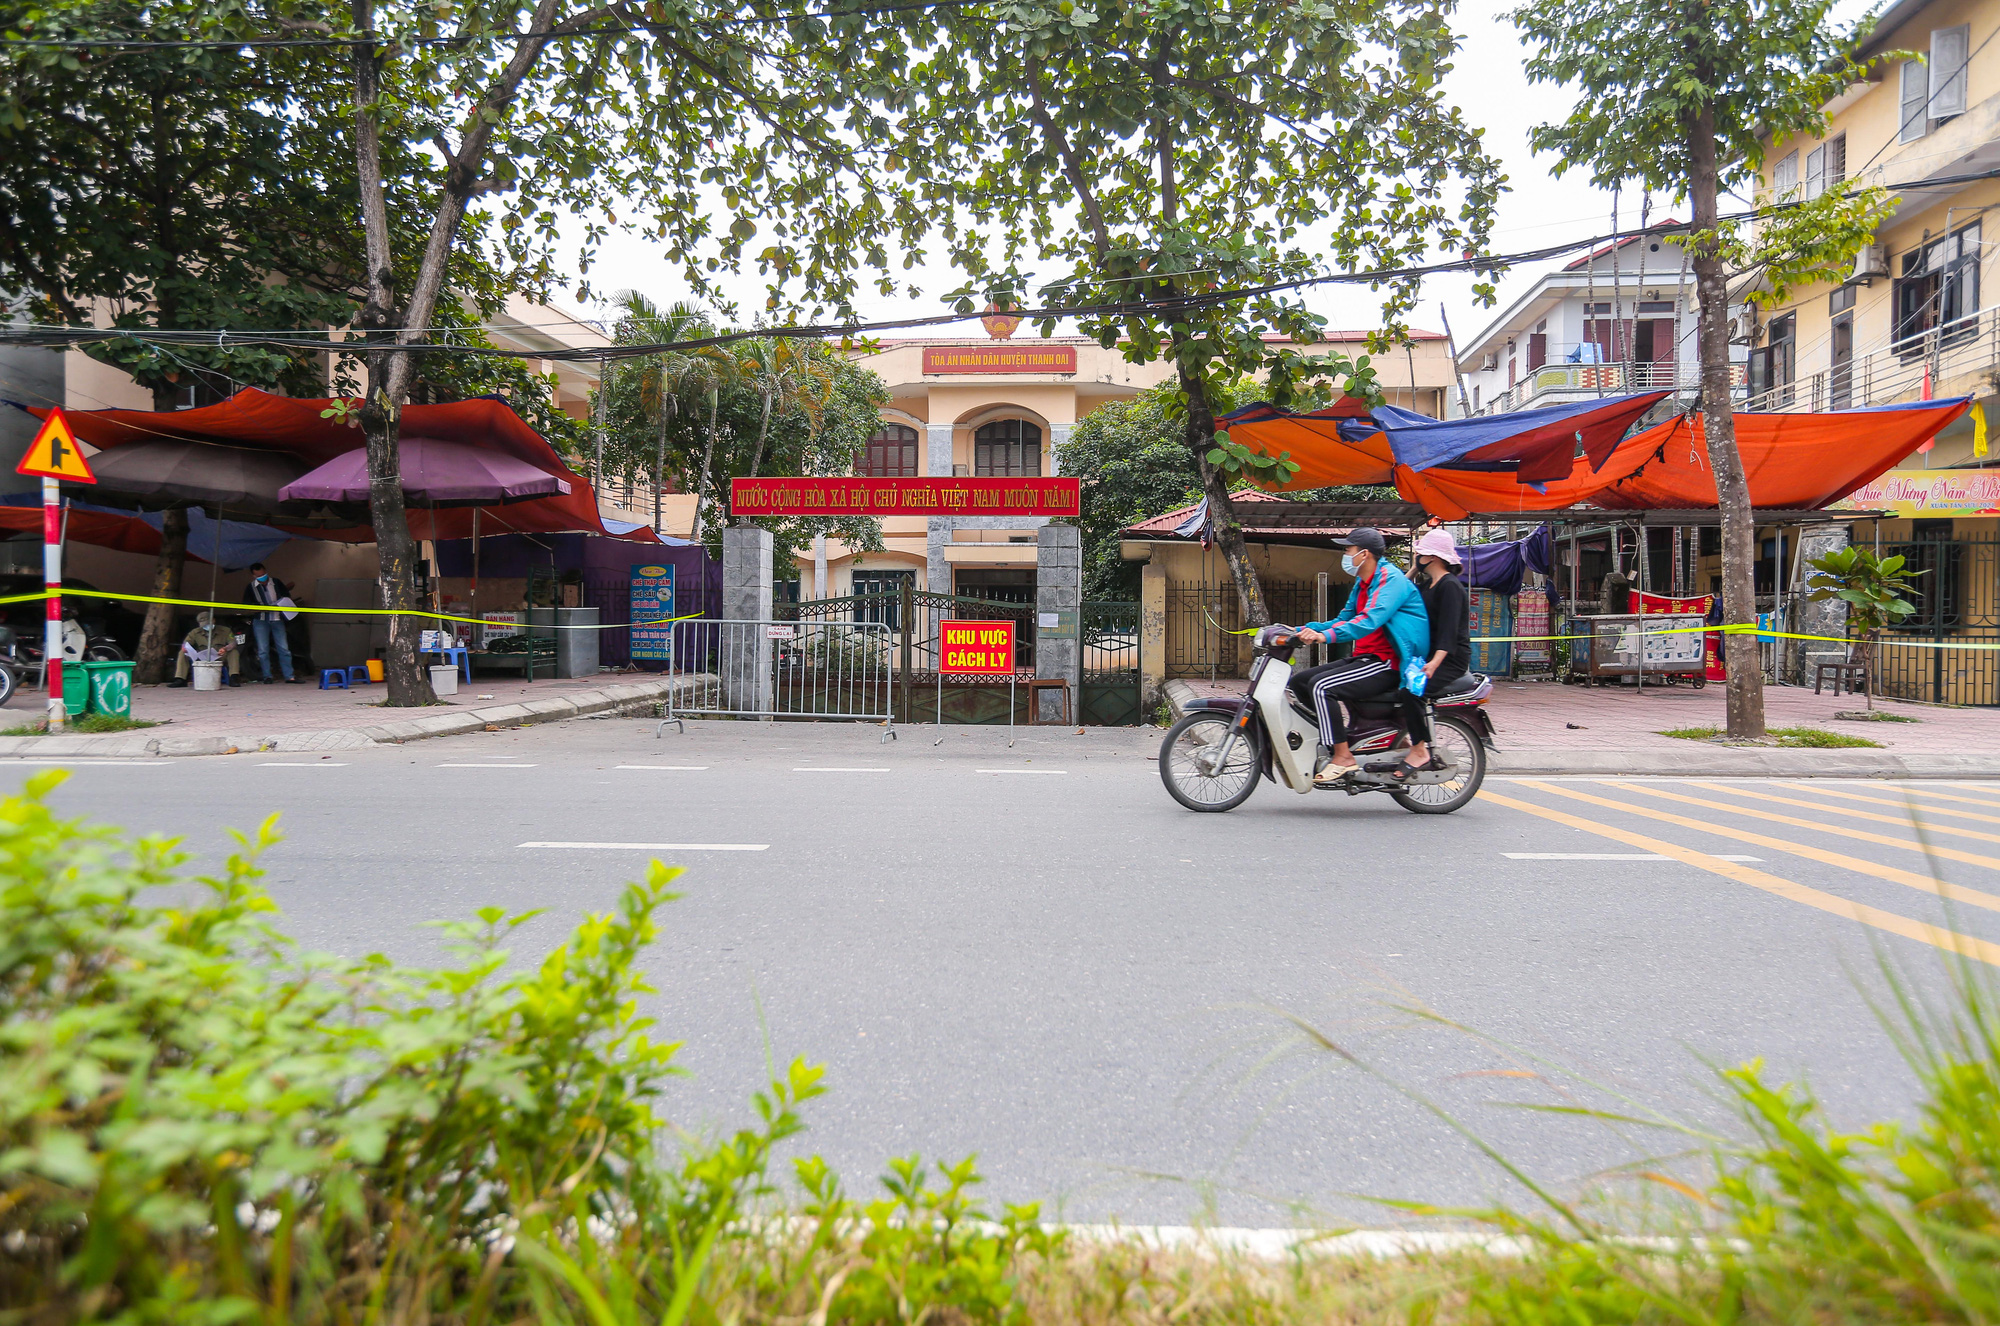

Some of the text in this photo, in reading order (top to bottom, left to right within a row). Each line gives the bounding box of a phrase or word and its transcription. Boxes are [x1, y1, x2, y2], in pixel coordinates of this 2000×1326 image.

[931, 352, 1069, 368] TÒA ÁN NHÂN DÂN HUYỆN THANH OAI
[736, 483, 768, 508] NƯỚC
[771, 484, 801, 511] CỘNG
[804, 483, 826, 508] HÒA
[829, 485, 847, 508] XÃ
[850, 484, 870, 511] HỘI
[874, 482, 898, 508] CHỦ
[901, 485, 938, 508] NGHĨA
[941, 483, 969, 511] VIỆT
[972, 489, 1000, 508] NAM
[1004, 483, 1039, 508] MUÔN
[1853, 482, 1882, 501] Chúc
[1885, 477, 1928, 511] Mừng
[1930, 476, 1966, 501] Năm
[947, 629, 1007, 648] KHU VỰC
[947, 649, 1007, 667] CÁCH LY
